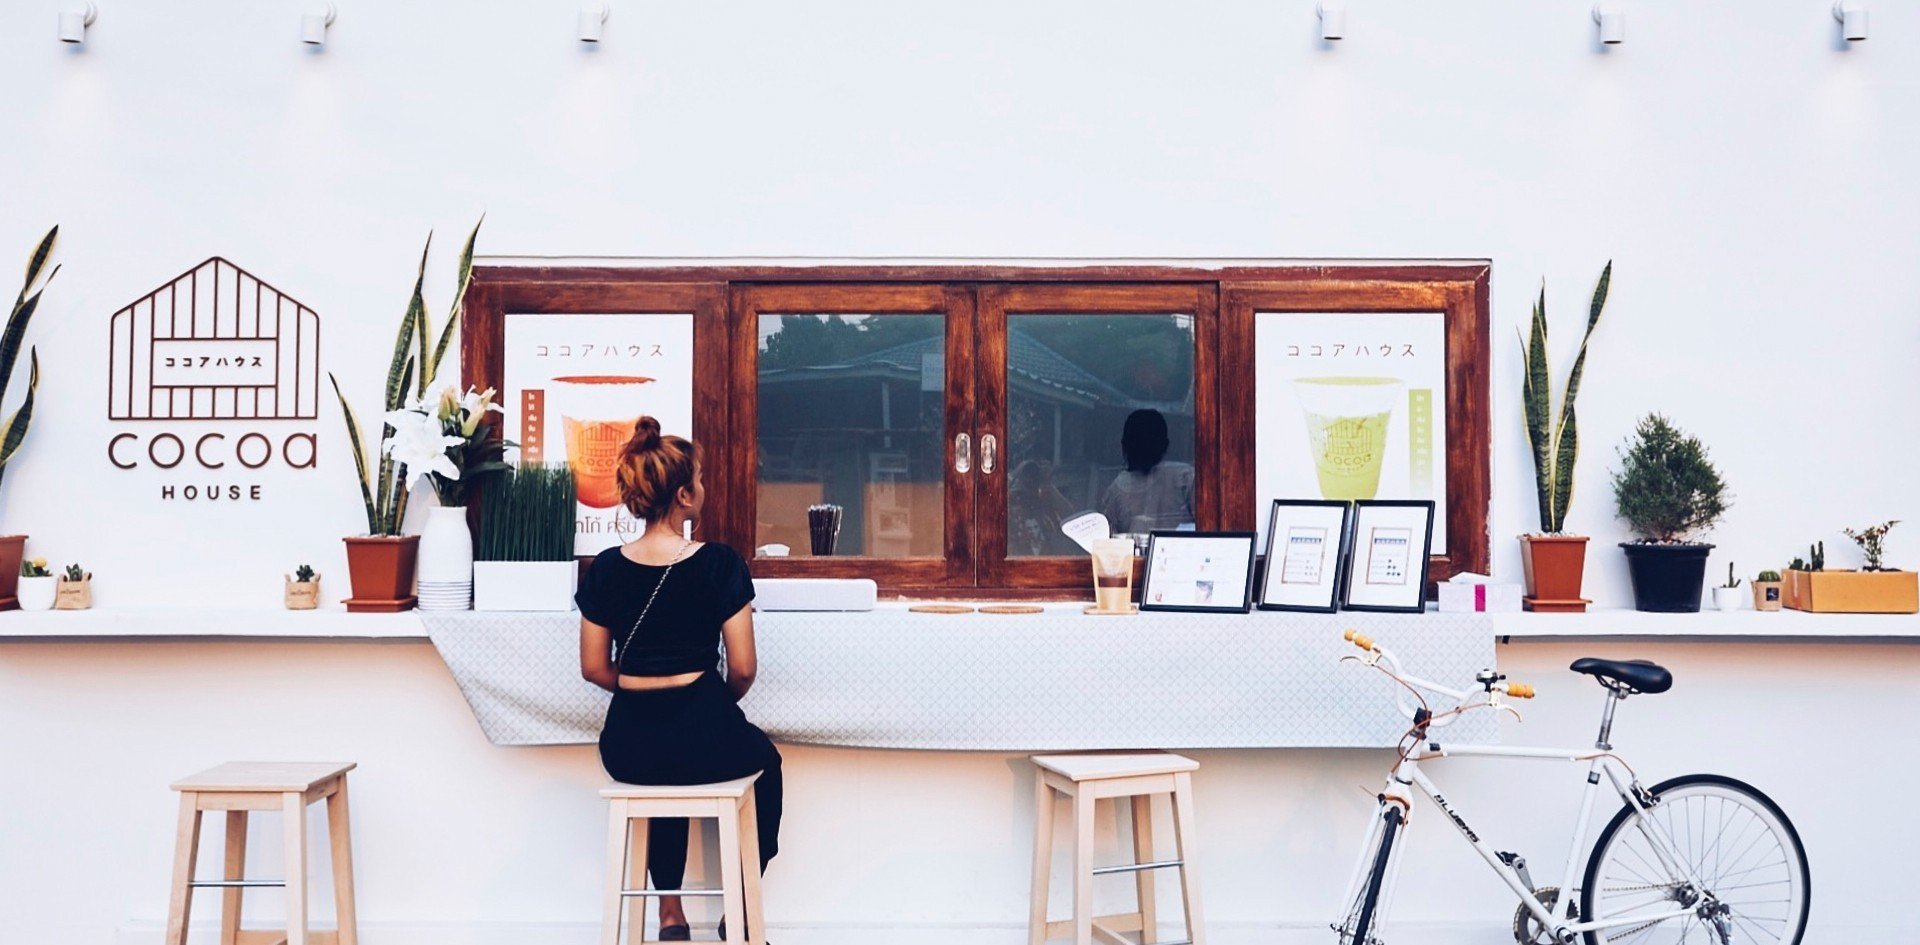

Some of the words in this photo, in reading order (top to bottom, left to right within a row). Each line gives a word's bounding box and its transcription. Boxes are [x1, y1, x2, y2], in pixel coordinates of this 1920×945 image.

[536, 343, 664, 357] ココアハウス
[1287, 343, 1416, 357] ココアハウス
[165, 356, 264, 368] ココアハウス
[107, 432, 318, 470] cocoa
[579, 456, 615, 467] coco
[161, 484, 262, 501] HOUSE
